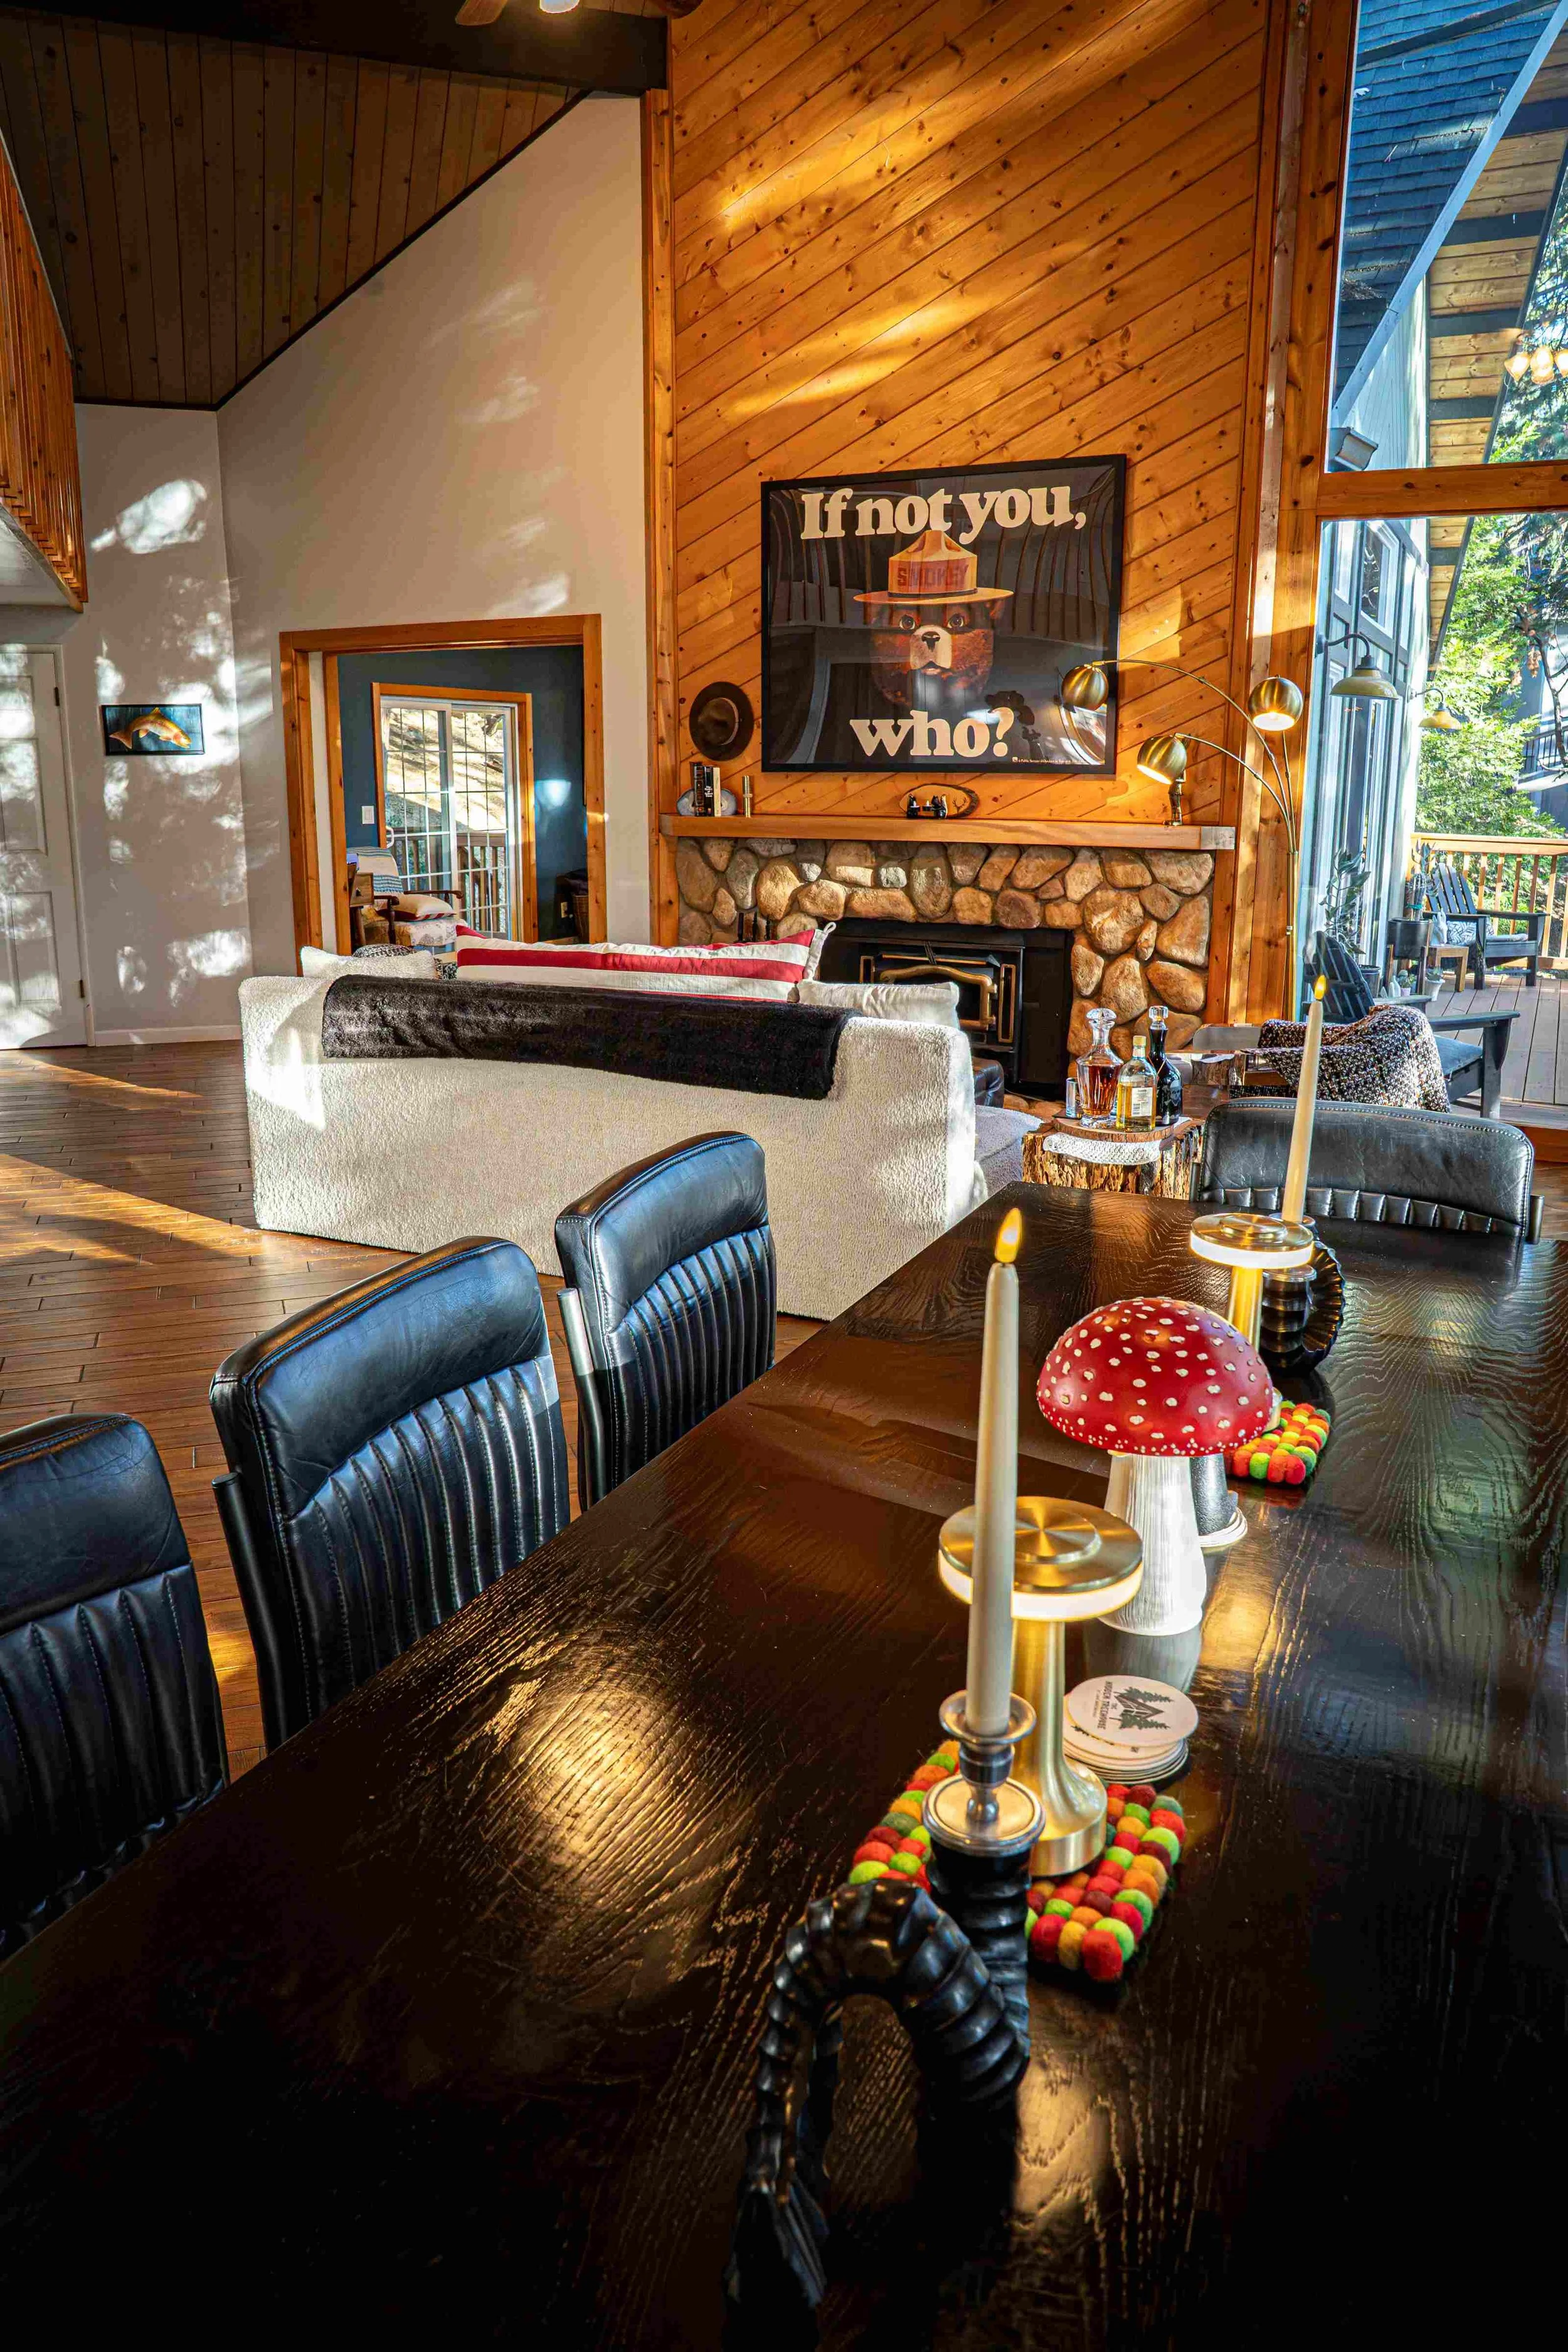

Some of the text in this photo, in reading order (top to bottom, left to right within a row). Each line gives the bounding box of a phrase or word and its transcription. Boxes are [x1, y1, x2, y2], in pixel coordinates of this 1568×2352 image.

[801, 485, 1086, 544] If not you,
[898, 563, 969, 588] SMOKEY
[849, 706, 1014, 758] who?
